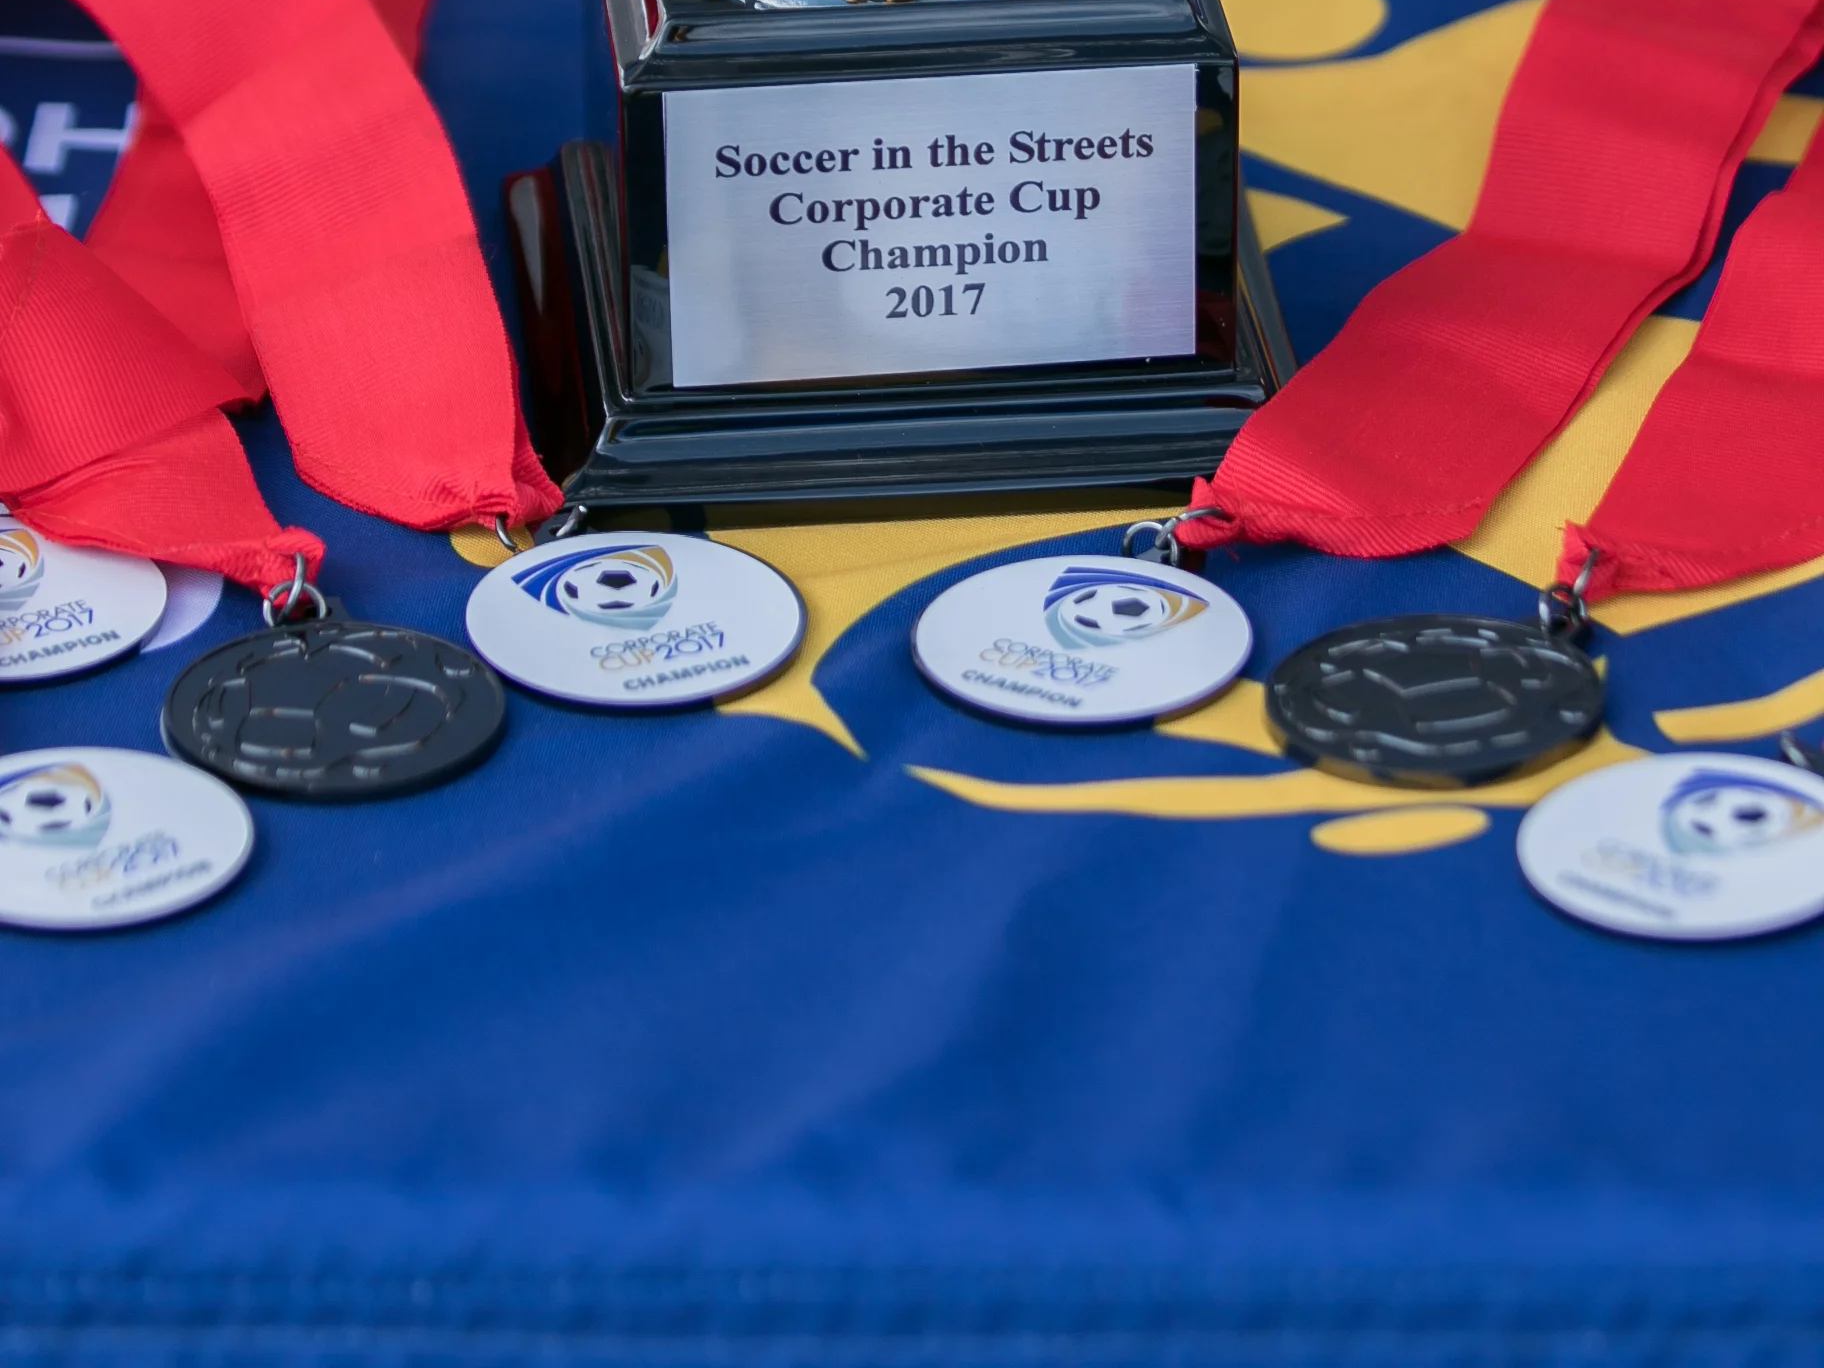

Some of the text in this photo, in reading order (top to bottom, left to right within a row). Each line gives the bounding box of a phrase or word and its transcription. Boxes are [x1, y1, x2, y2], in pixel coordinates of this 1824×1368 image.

[714, 128, 1154, 179] Soccer in the Streets
[768, 179, 1101, 231] Corporate Cup
[821, 232, 1050, 276] Champion
[884, 282, 987, 320] 2017
[590, 621, 720, 659] CORPORATE
[623, 653, 750, 691] CHAMPION
[960, 668, 1083, 708] CHAMPION
